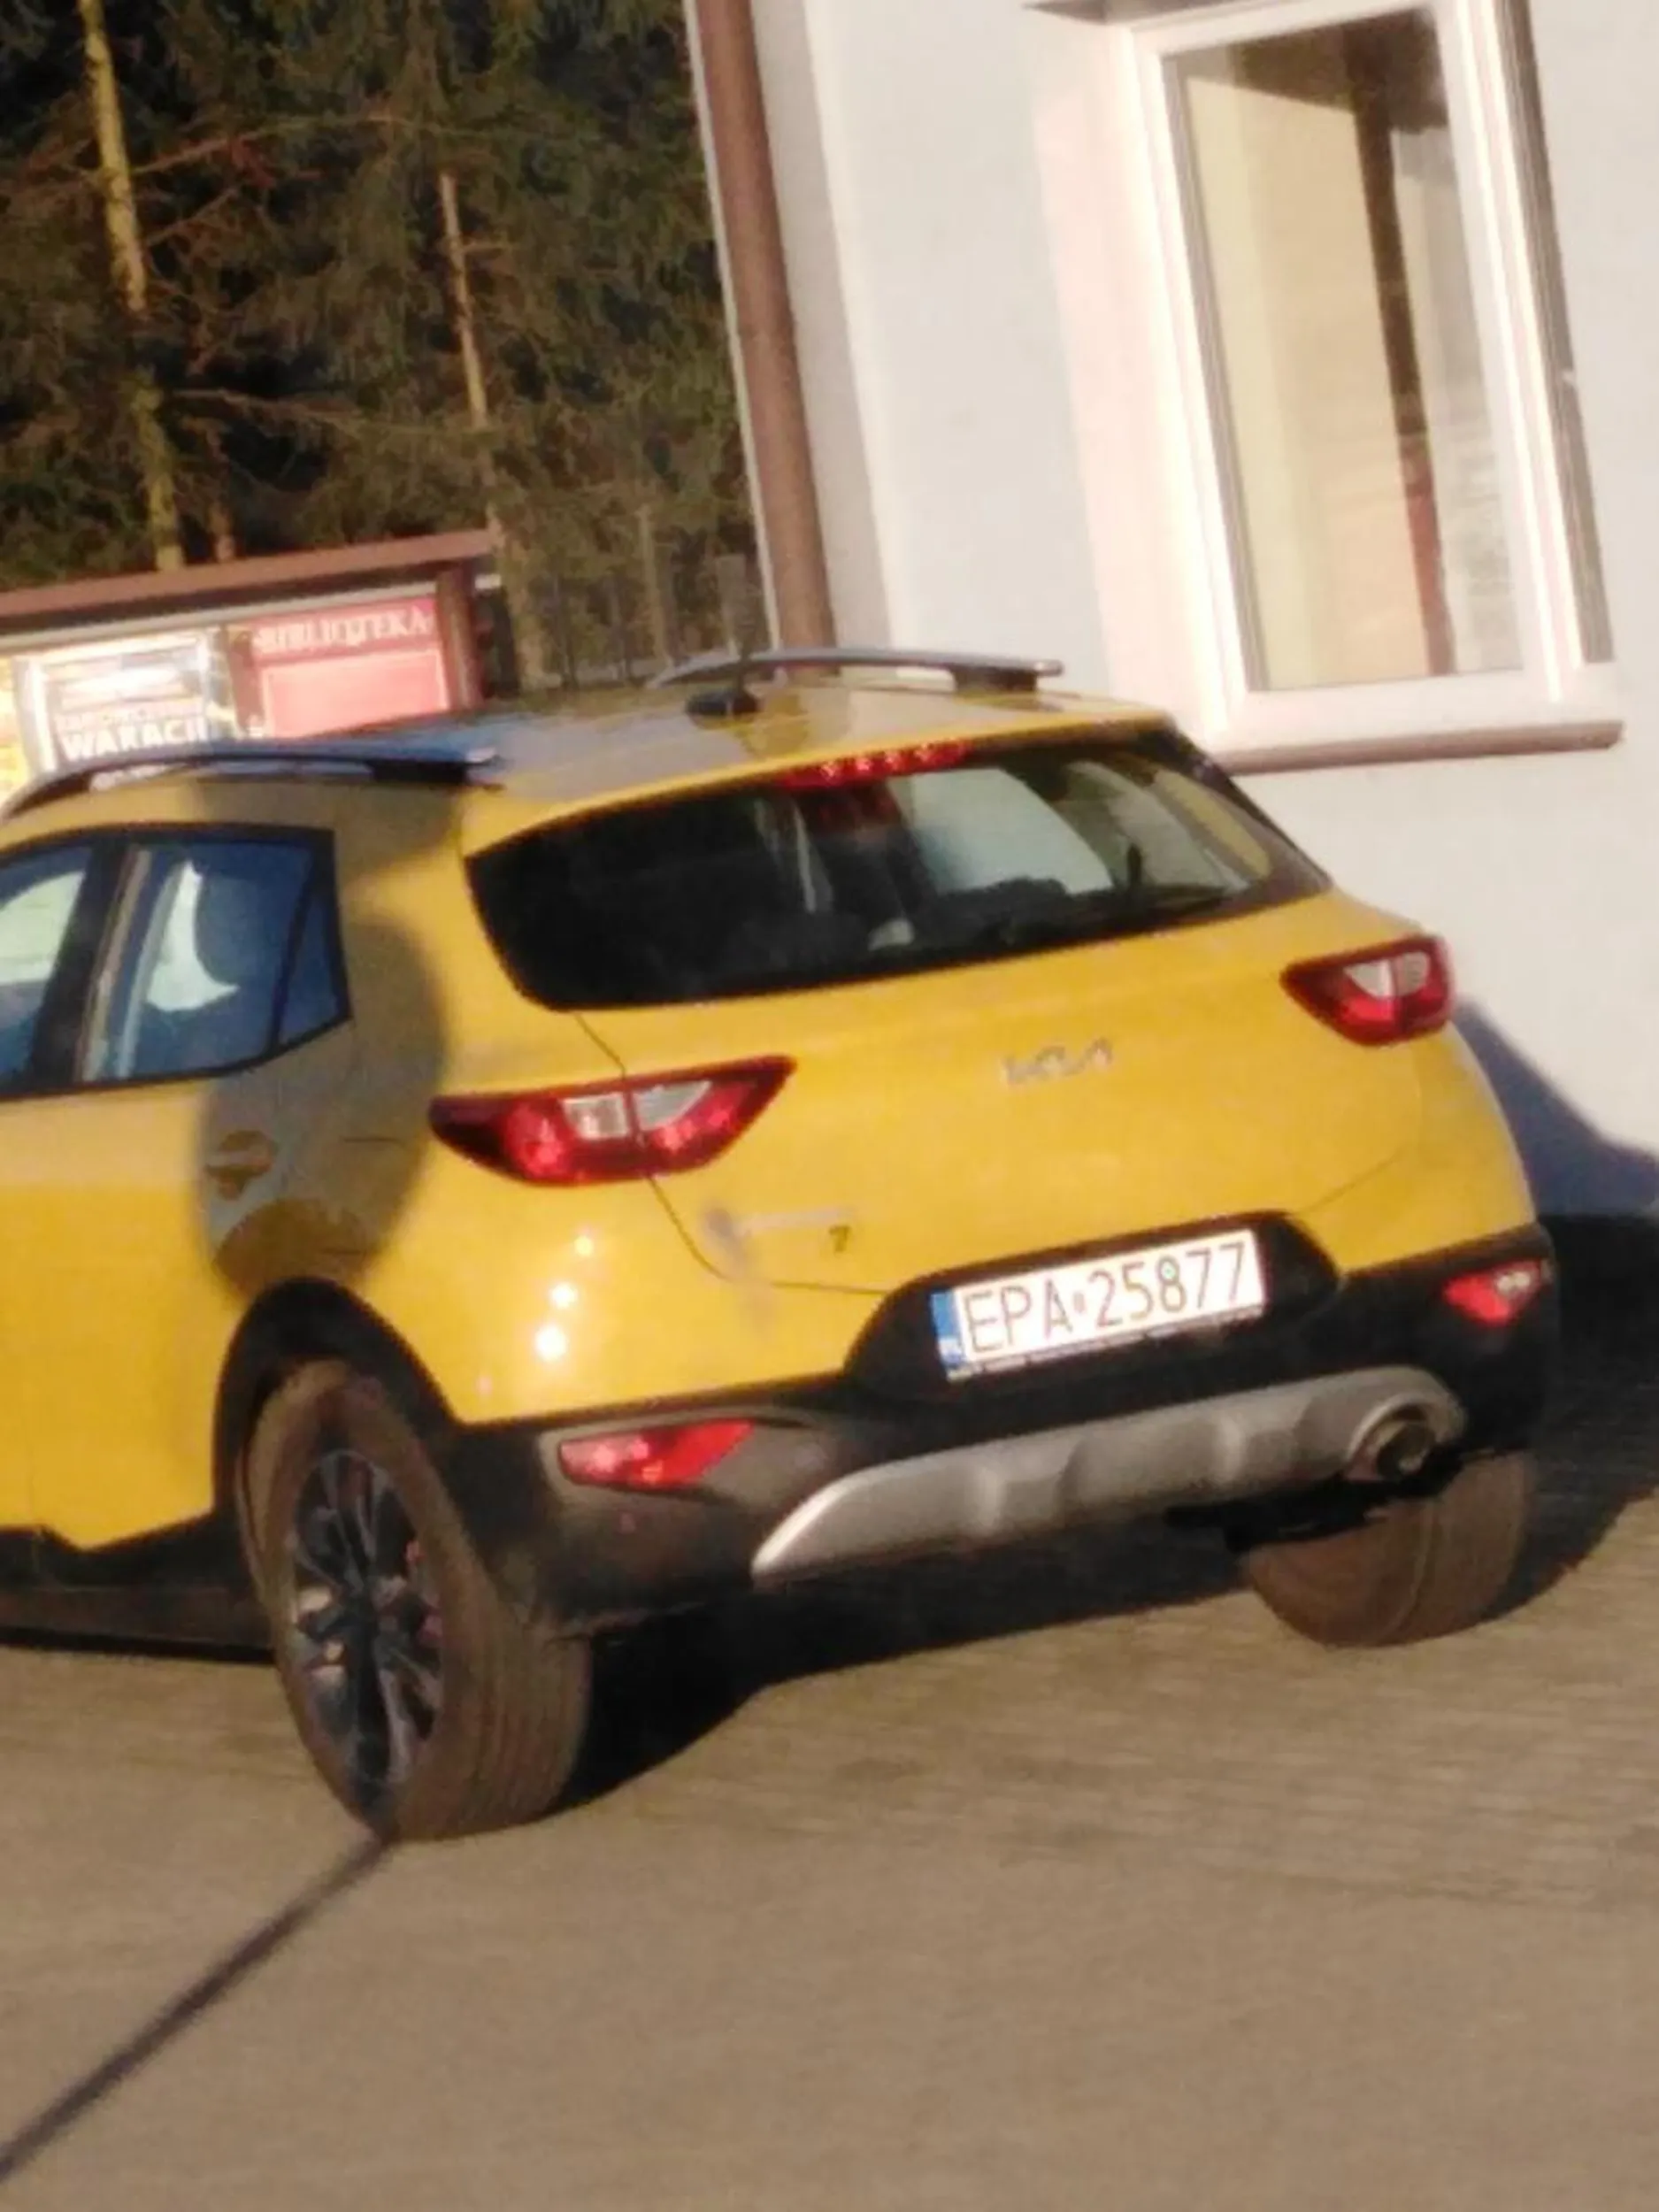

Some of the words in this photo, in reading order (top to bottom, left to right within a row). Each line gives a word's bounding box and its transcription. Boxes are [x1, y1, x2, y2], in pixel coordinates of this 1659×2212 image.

[253, 605, 432, 654] BIBLIOTEKA
[964, 1278, 1073, 1354] EPA
[1088, 1241, 1246, 1328] 25877
